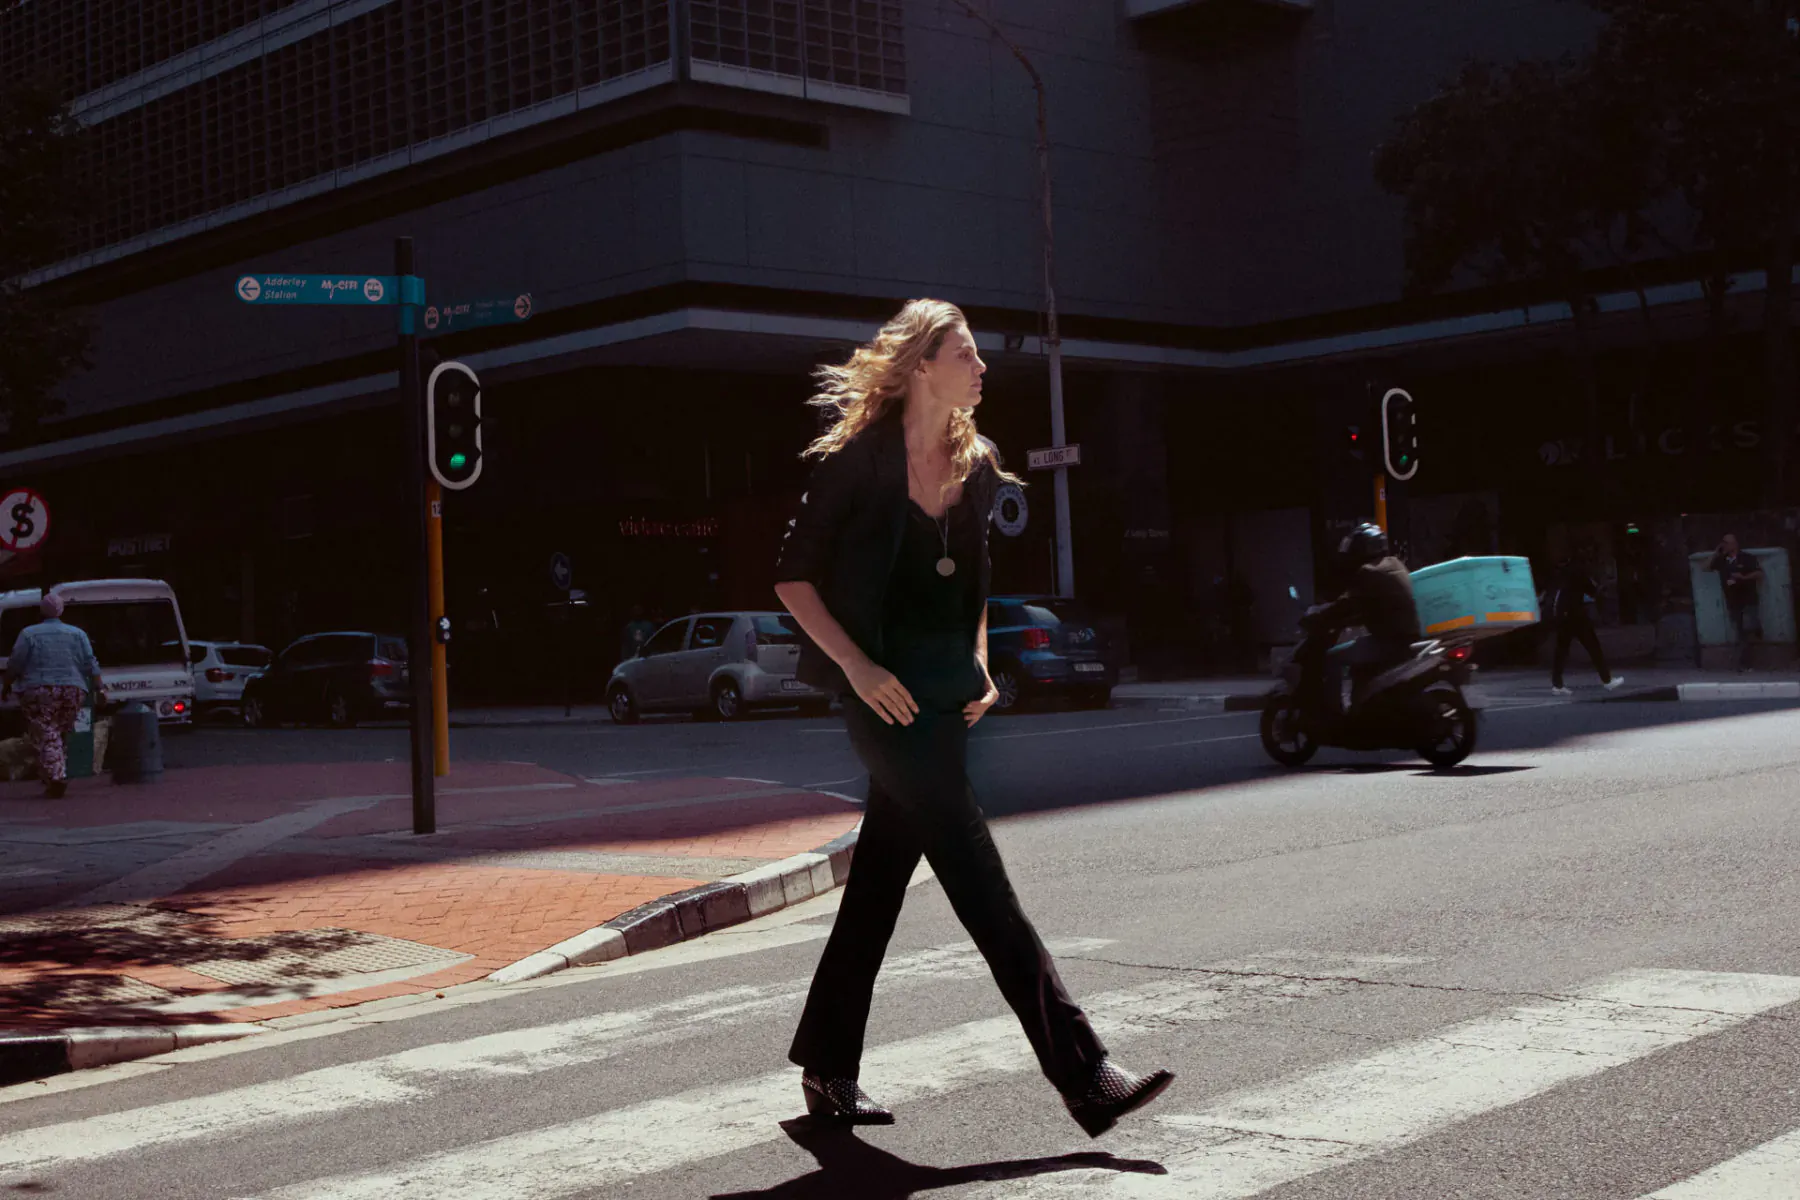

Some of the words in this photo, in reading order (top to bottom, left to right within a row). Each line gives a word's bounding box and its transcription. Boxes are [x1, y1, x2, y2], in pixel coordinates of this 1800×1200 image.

[264, 276, 307, 288] Adderley
[264, 290, 298, 300] Station
[1044, 450, 1064, 464] LONG
